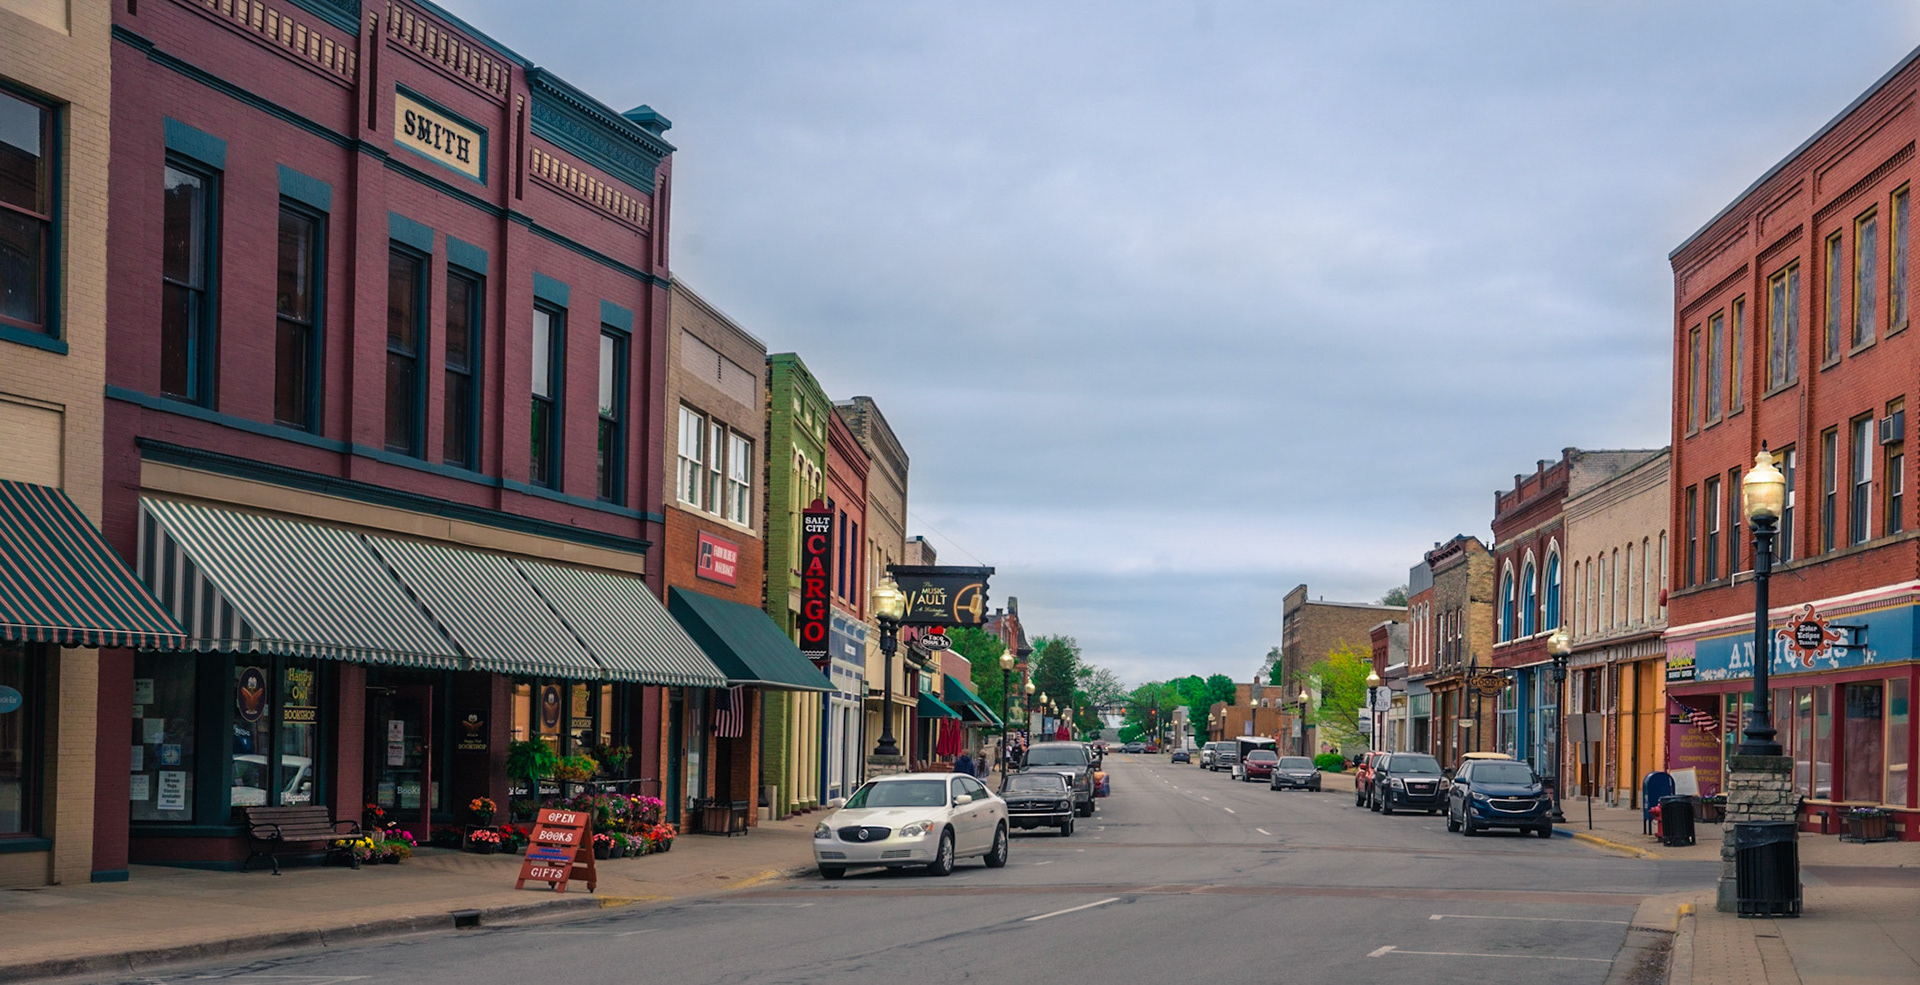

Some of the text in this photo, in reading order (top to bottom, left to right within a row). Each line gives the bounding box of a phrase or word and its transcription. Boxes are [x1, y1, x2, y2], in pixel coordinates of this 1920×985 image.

[403, 109, 471, 164] SMITH
[805, 516, 830, 525] SALT
[805, 525, 829, 533] CITY
[804, 534, 827, 642] CARGO
[1799, 624, 1818, 632] Solar
[1797, 631, 1820, 641] Eclipse
[288, 667, 313, 687] Happy
[292, 685, 308, 700] Owl
[283, 709, 316, 720] BOOKSHOP
[548, 812, 576, 824] OPEN
[538, 830, 573, 842] BOOKS
[530, 867, 564, 879] GIFTS
